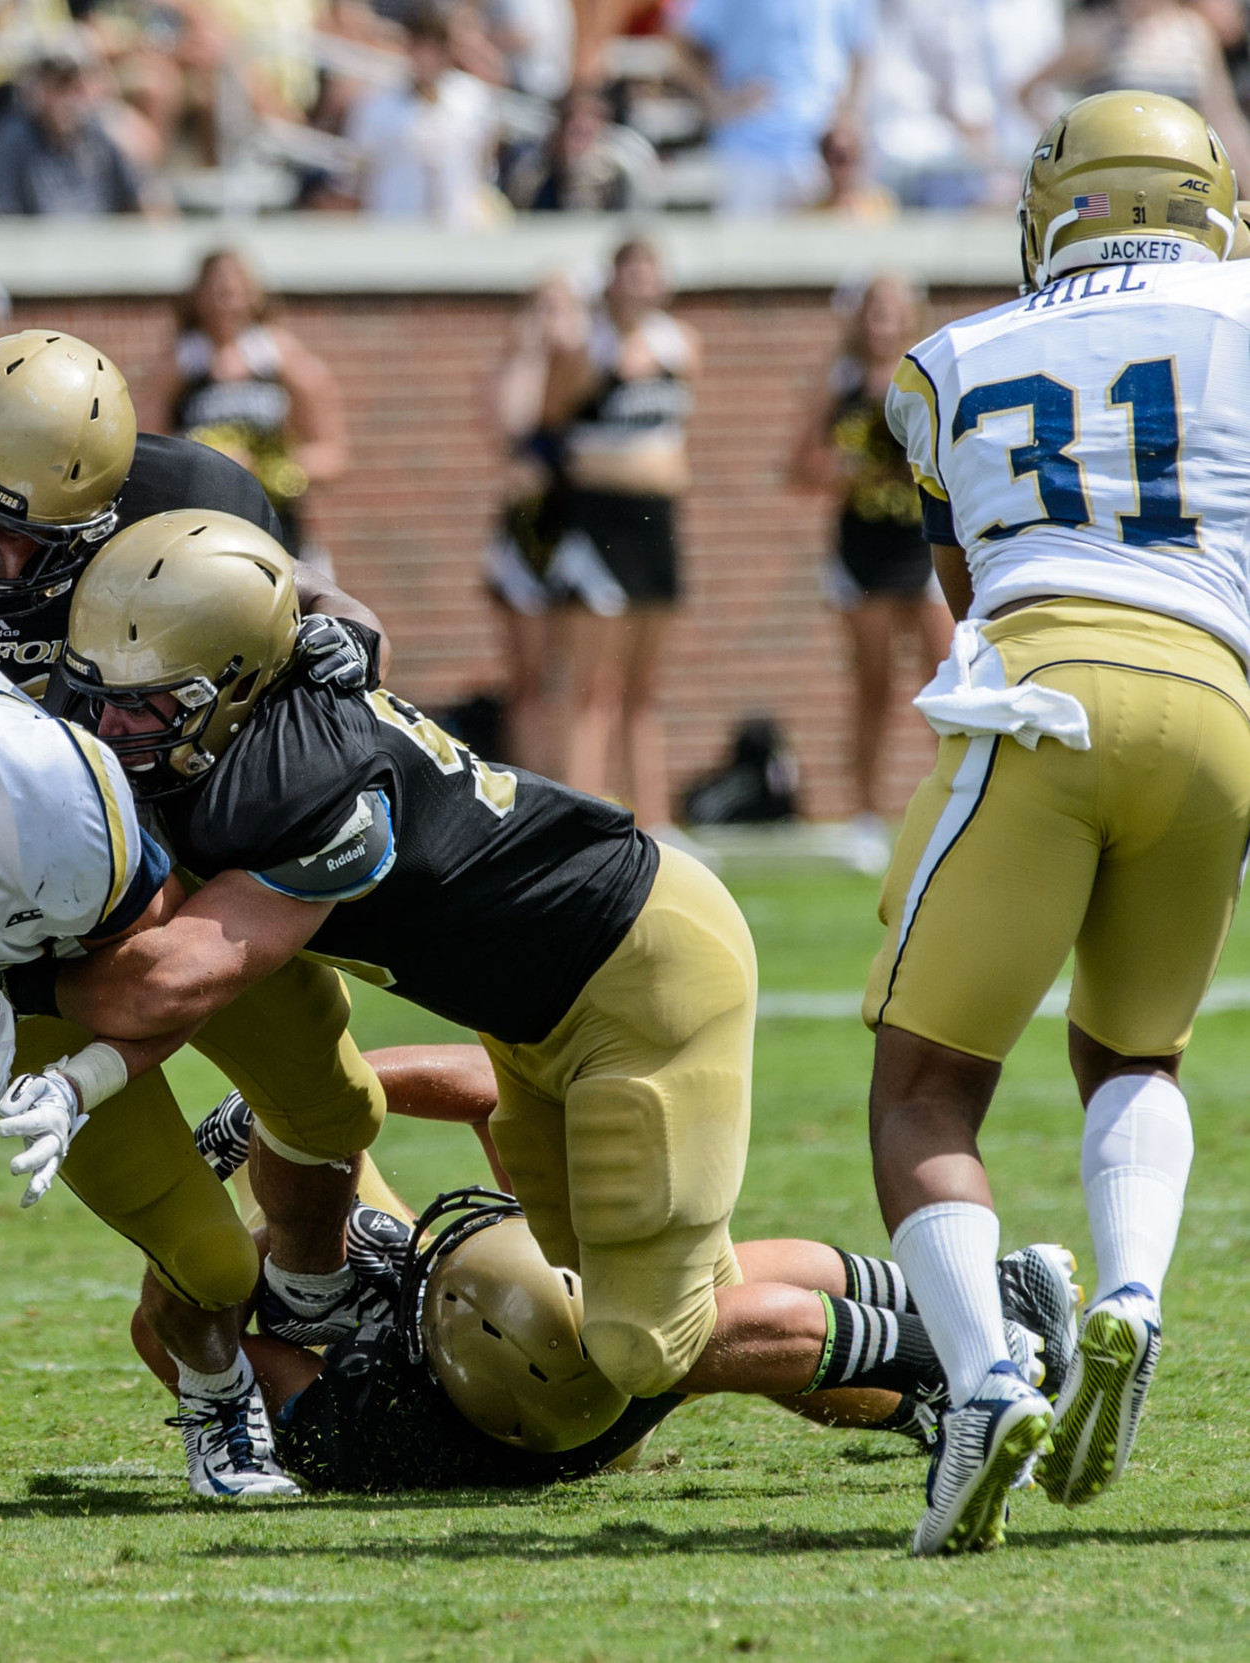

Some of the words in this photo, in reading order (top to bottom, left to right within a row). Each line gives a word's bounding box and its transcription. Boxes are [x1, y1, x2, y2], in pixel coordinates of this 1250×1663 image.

[1179, 178, 1211, 194] ACC
[1132, 206, 1147, 225] 31
[1100, 239, 1182, 261] JACKETS
[1023, 263, 1147, 312] HILL
[951, 354, 1206, 555] 31
[326, 844, 367, 872] Riddell
[4, 908, 44, 929] ACC
